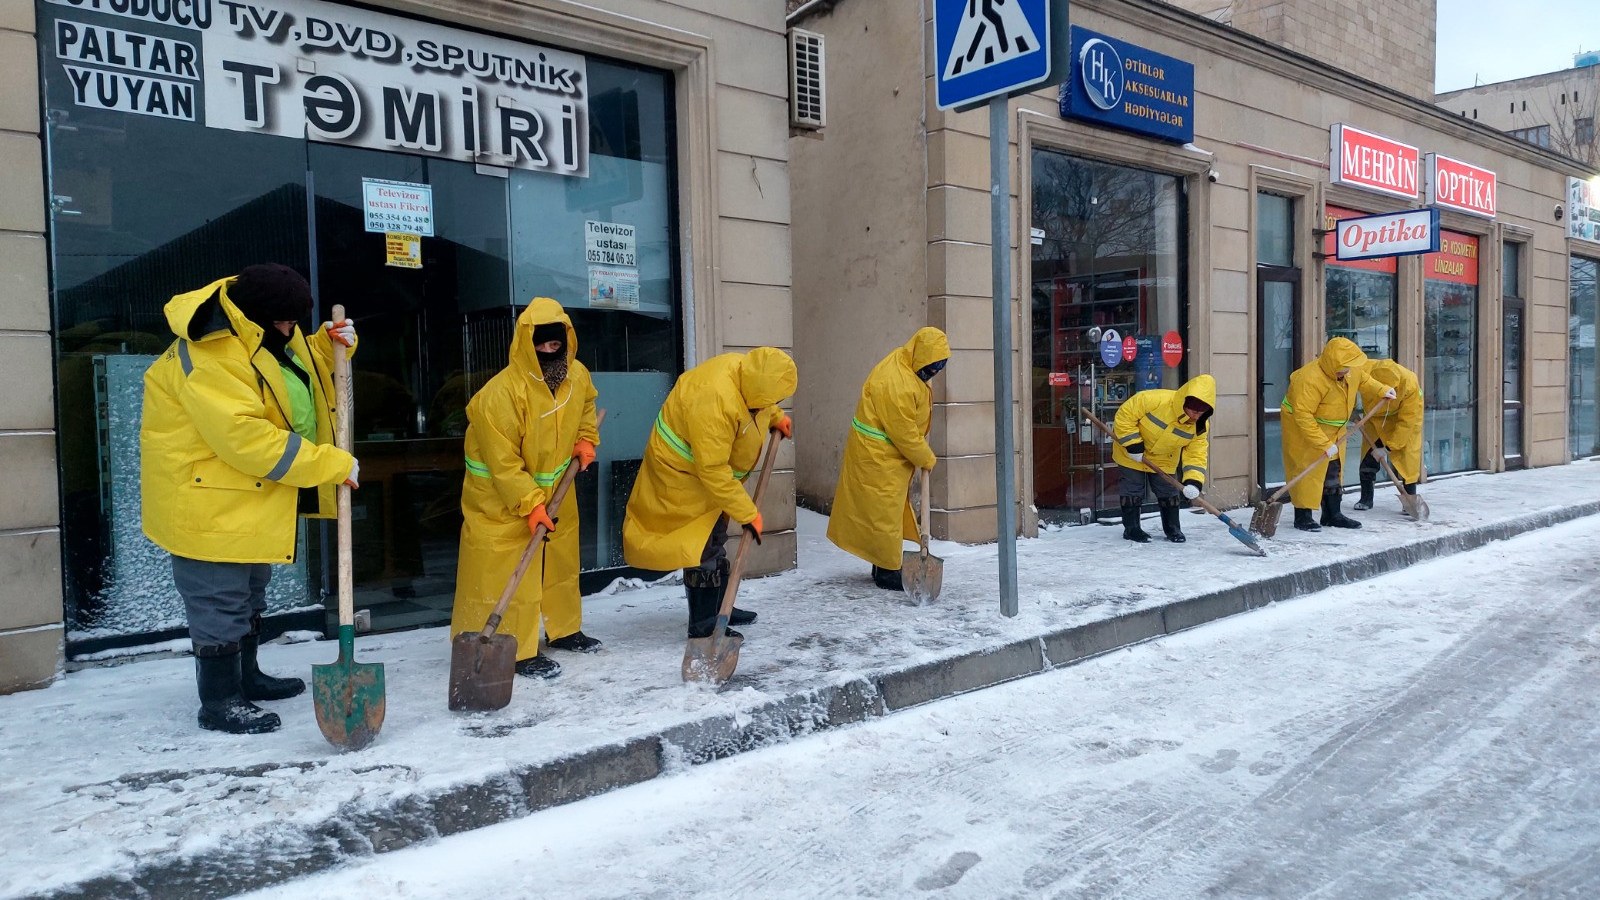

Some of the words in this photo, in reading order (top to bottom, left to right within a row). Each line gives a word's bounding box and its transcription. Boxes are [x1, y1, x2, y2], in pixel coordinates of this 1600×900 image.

[58, 21, 196, 77] PALTAR
[1125, 58, 1165, 81] ƏTİRLƏR
[68, 68, 193, 118] YUYAN
[1125, 80, 1188, 107] AKSESUARLAR
[222, 60, 575, 167] TƏMİRİ
[1124, 102, 1183, 127] HƏDİYYƏLƏR
[1344, 141, 1417, 191] MEHRİN
[376, 188, 420, 200] Televizor
[1437, 169, 1495, 212] OPTİKA
[369, 212, 384, 220] 055
[369, 221, 384, 229] 050
[588, 222, 634, 237] Televizor
[1343, 219, 1428, 252] Optika
[587, 249, 601, 261] 055
[602, 251, 615, 263] 784
[596, 239, 627, 250] ustası
[1434, 256, 1464, 276] LİNZALAR
